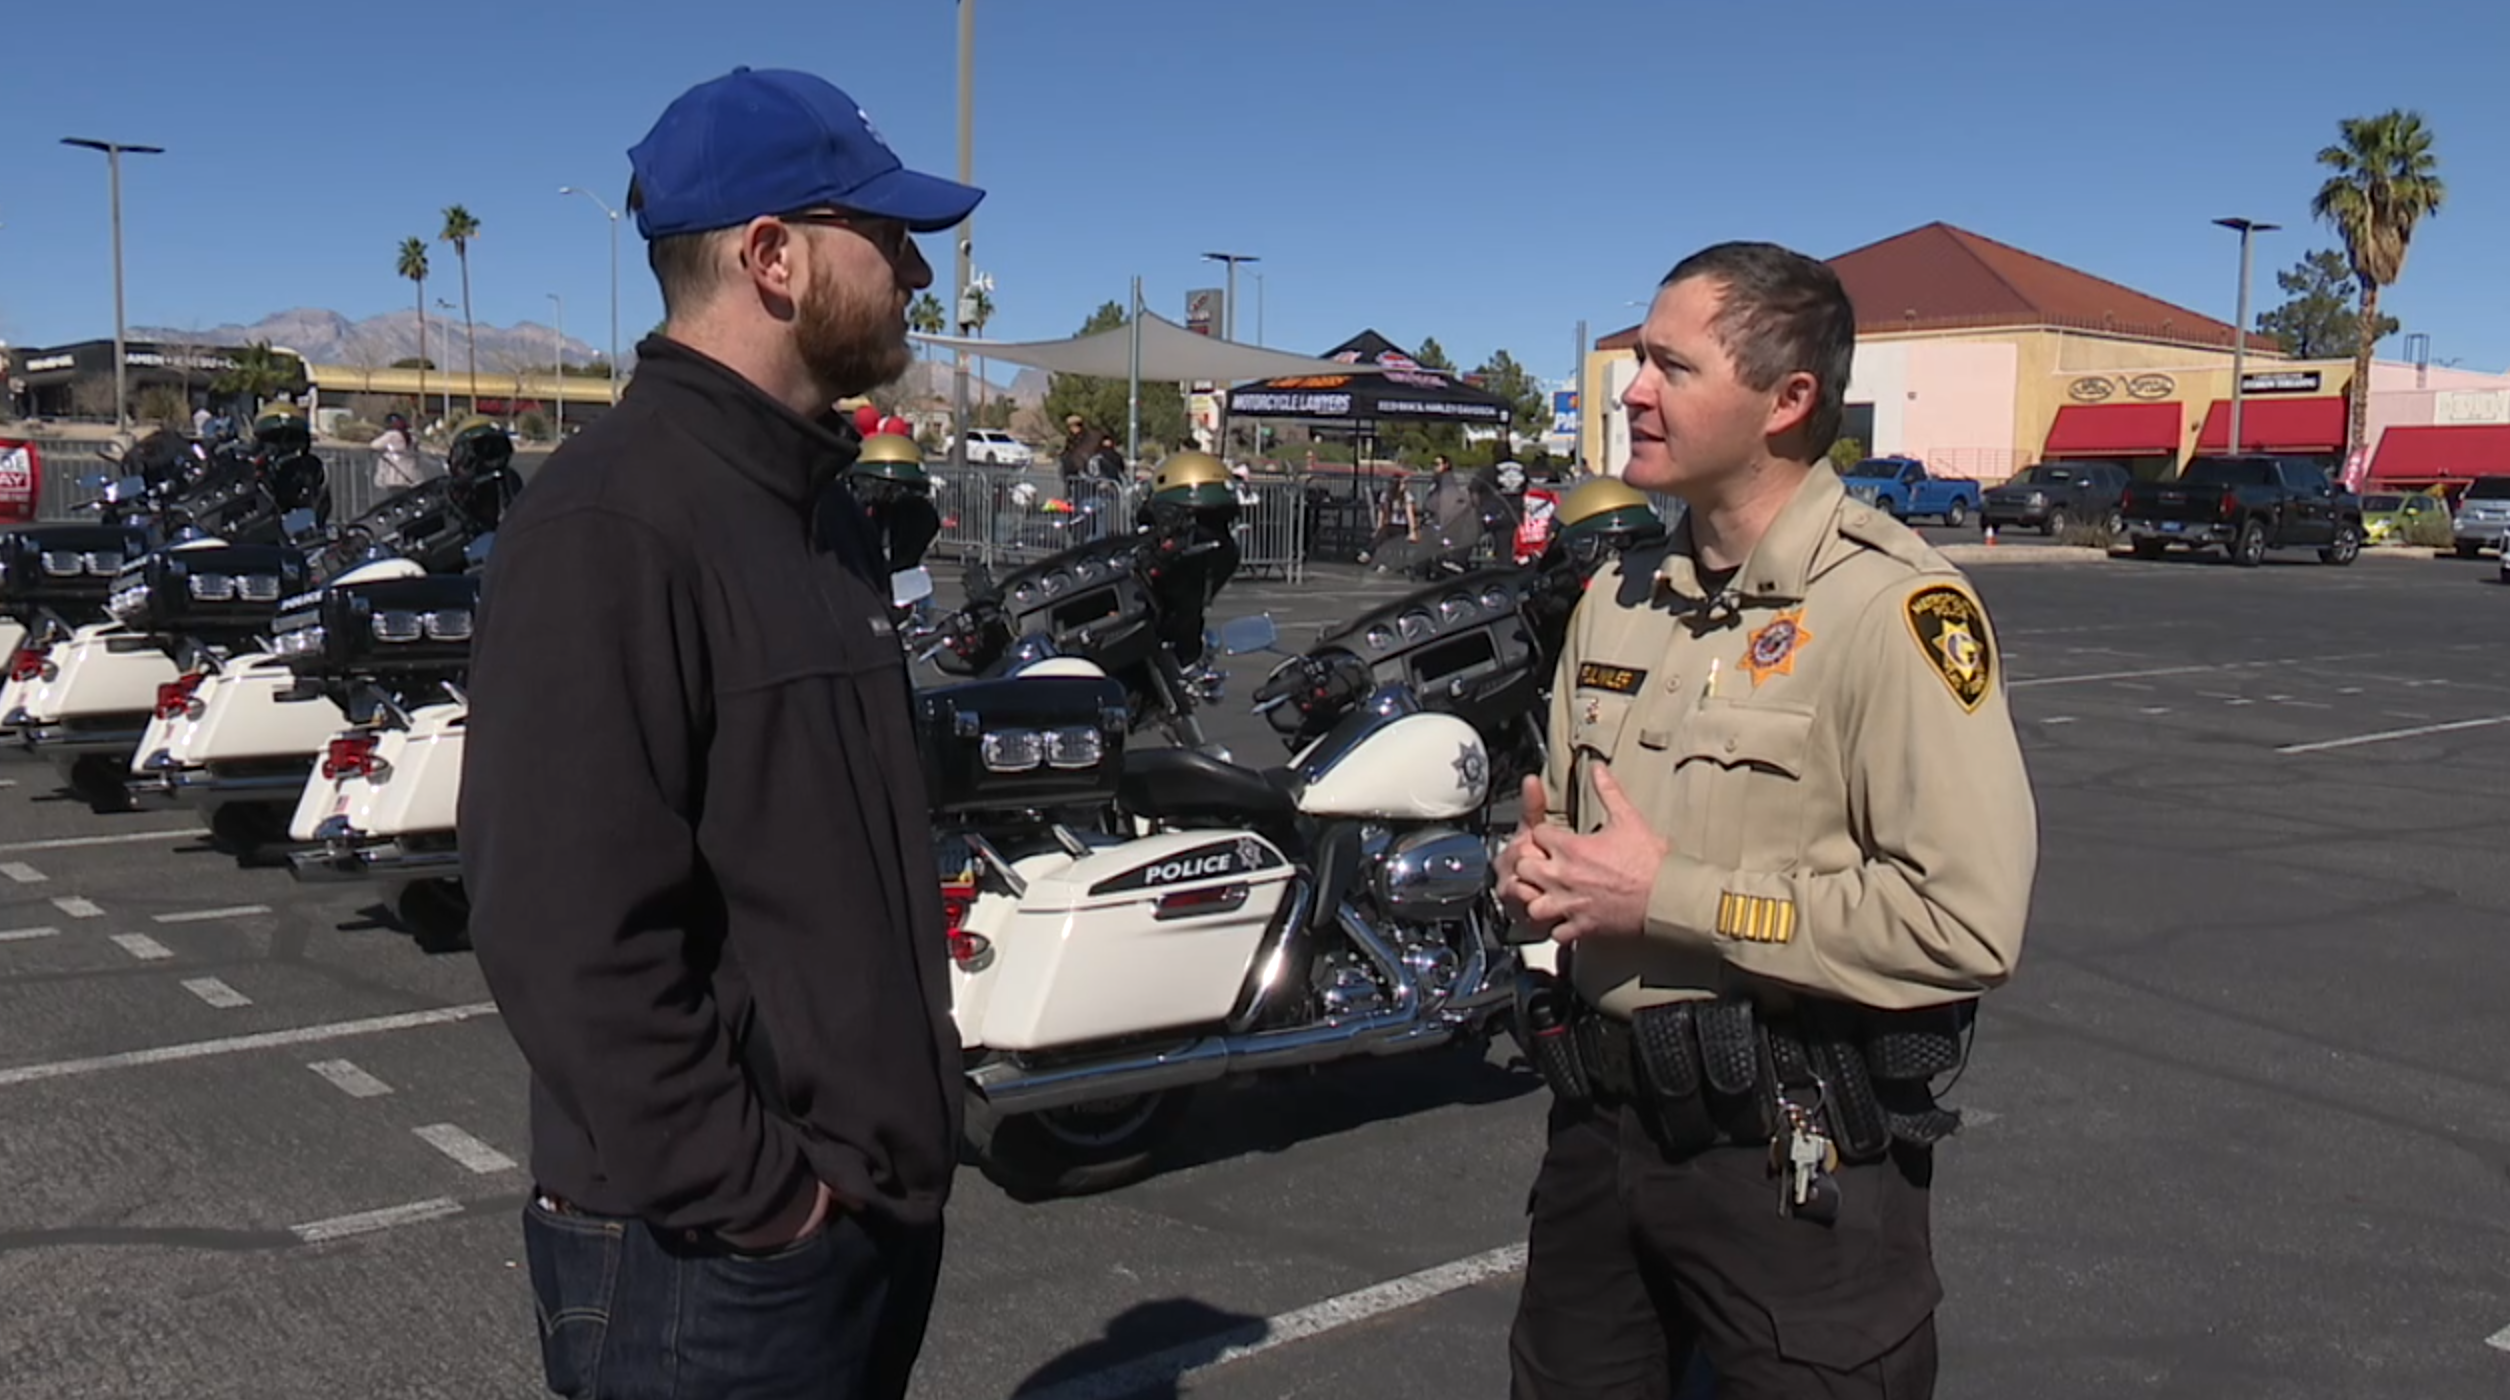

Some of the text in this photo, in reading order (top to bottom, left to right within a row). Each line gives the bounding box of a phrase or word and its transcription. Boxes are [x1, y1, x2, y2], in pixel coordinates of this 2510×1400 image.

[124, 353, 164, 367] AMEN
[1232, 393, 1298, 411] MOTORCYCLE
[1144, 853, 1232, 885] POLICE
